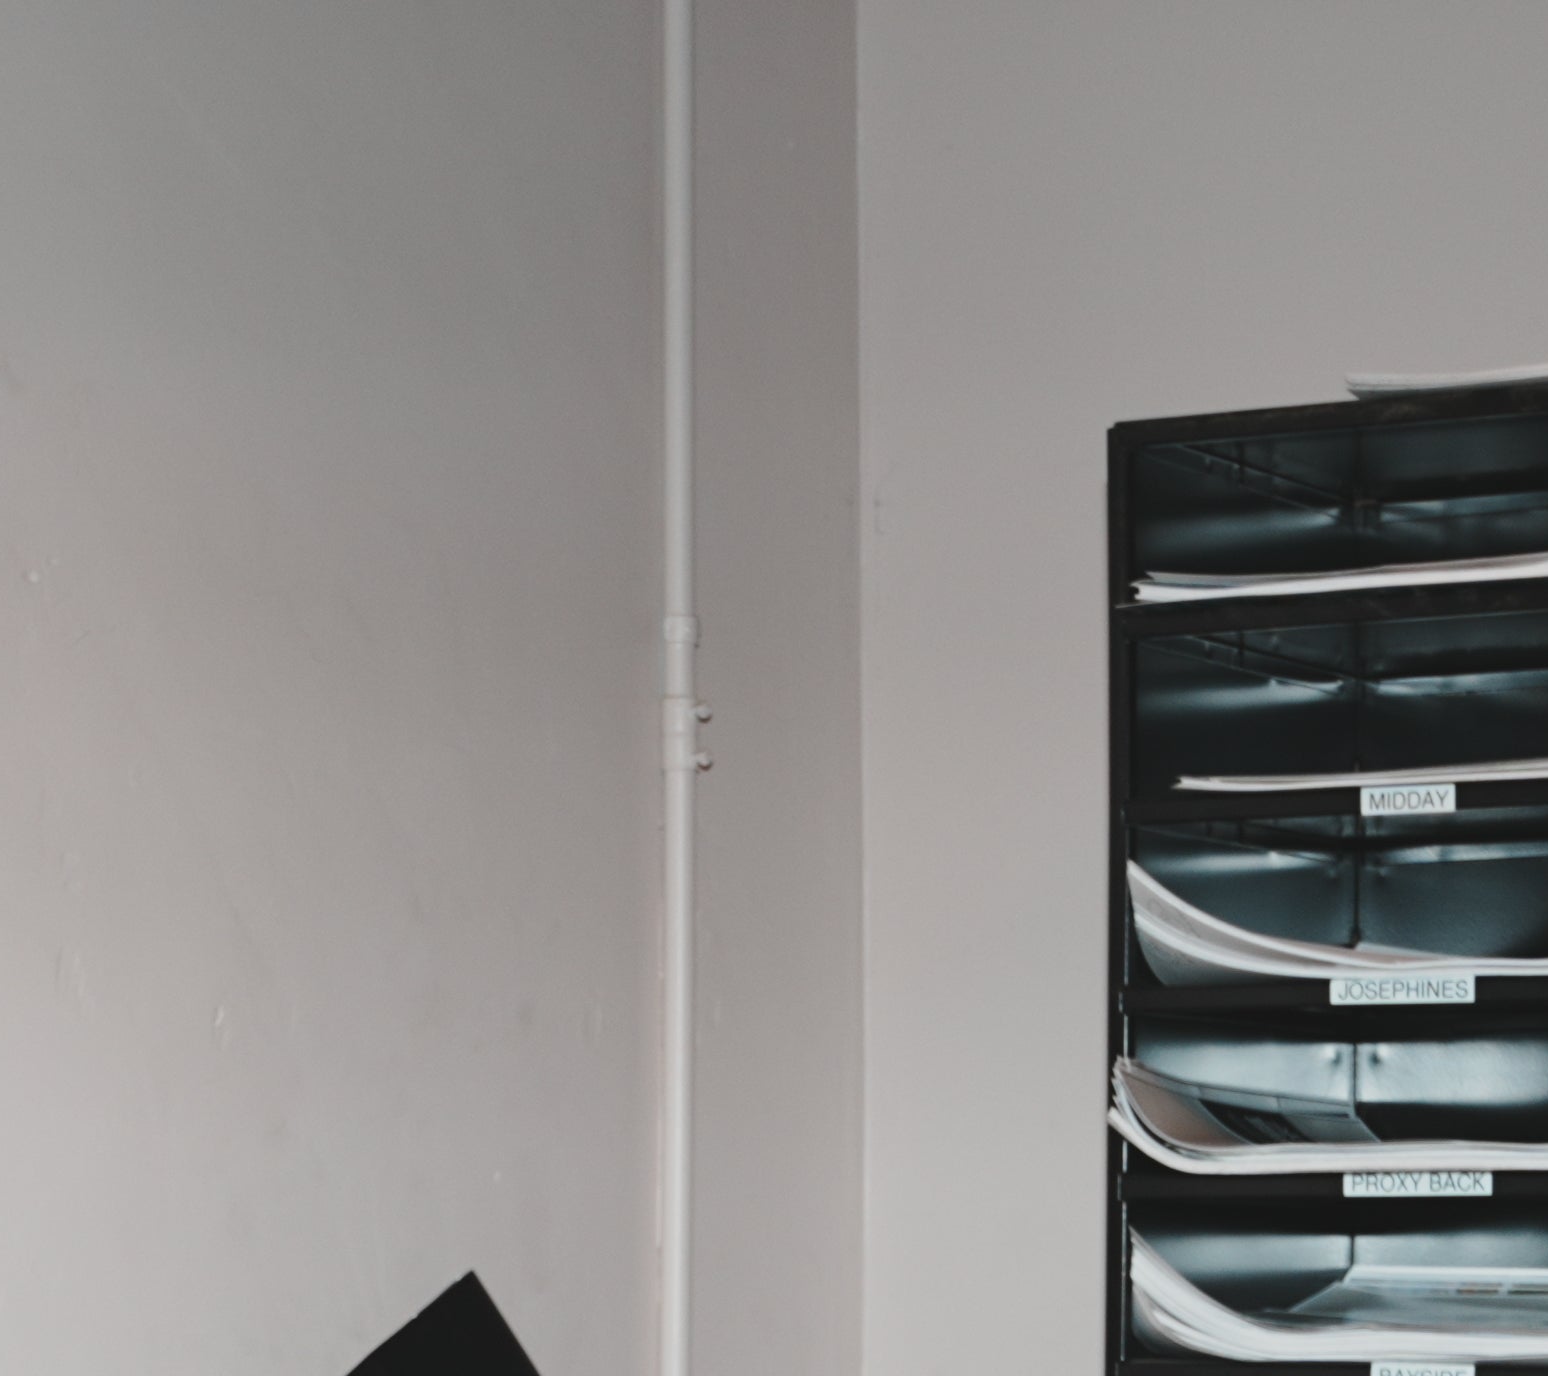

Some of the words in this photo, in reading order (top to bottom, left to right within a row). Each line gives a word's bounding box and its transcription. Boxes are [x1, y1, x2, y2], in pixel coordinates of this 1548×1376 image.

[1369, 790, 1450, 811] MIDDAY
[1337, 979, 1469, 1001] JOSEPHINES
[1351, 1172, 1421, 1194] PROXY
[1432, 1171, 1486, 1192] BACK
